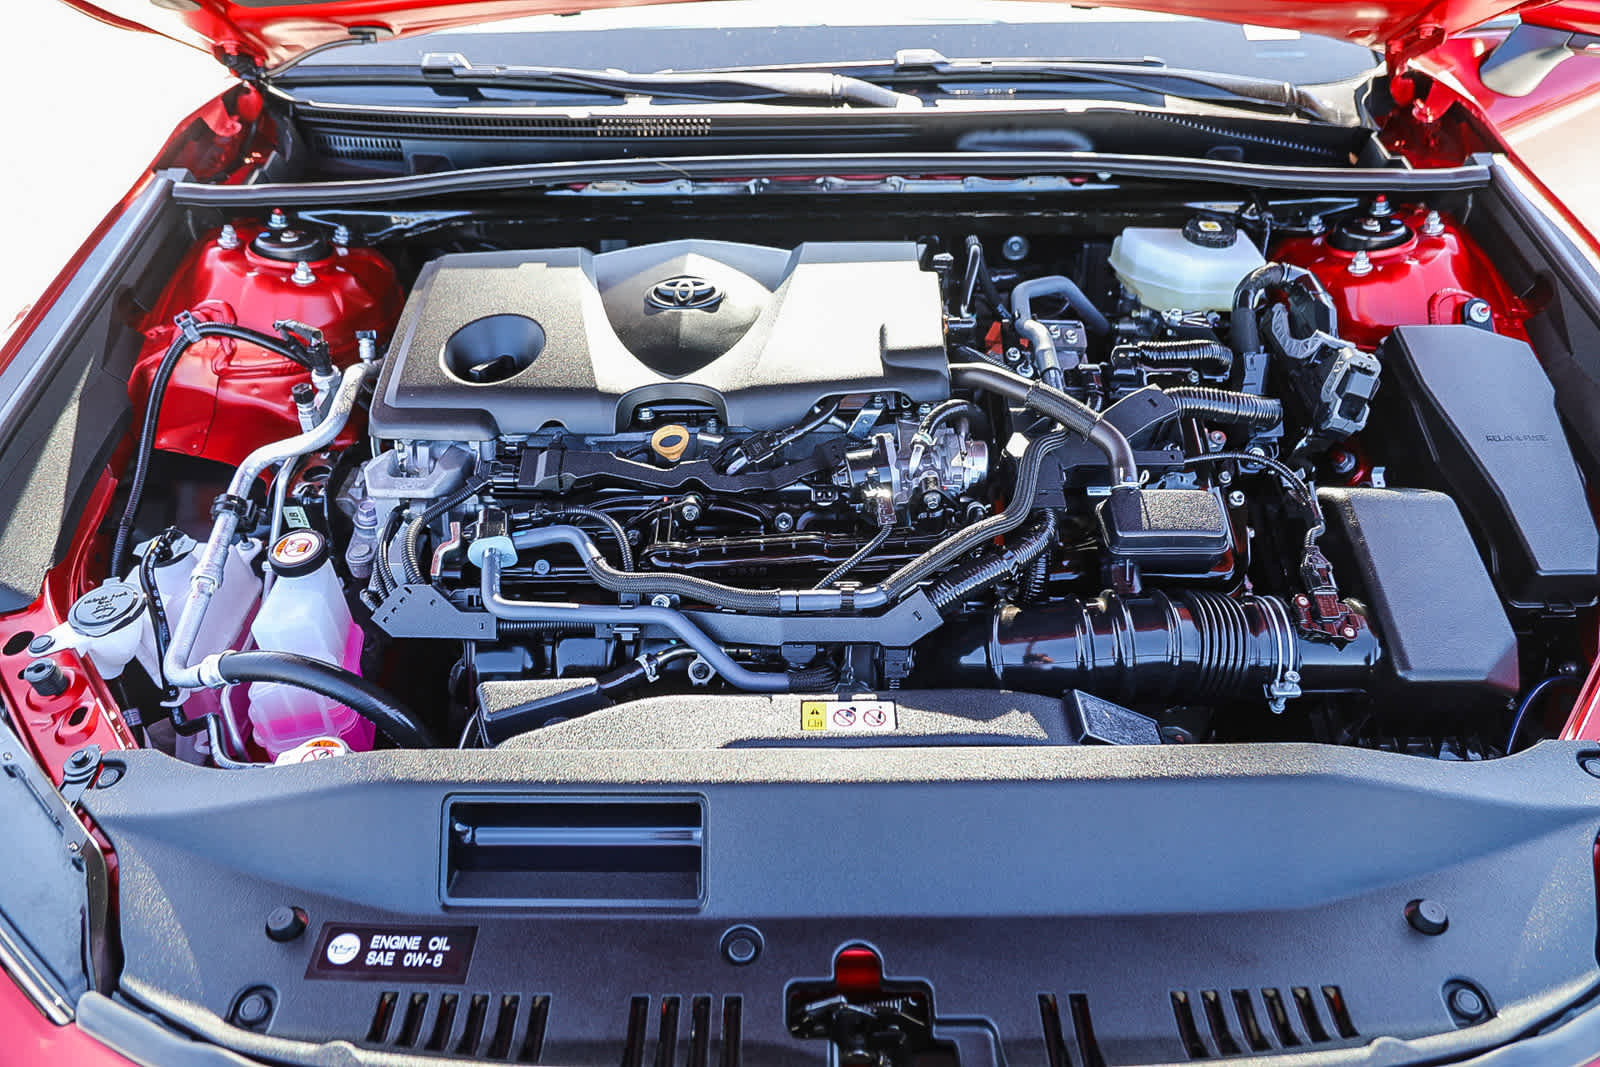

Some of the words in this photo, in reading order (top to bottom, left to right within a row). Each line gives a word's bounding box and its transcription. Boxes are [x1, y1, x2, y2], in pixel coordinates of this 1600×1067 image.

[370, 935, 421, 950] ENGINE
[428, 936, 451, 951] OIL
[366, 951, 395, 966] SAE
[403, 952, 443, 967] 0W-8
